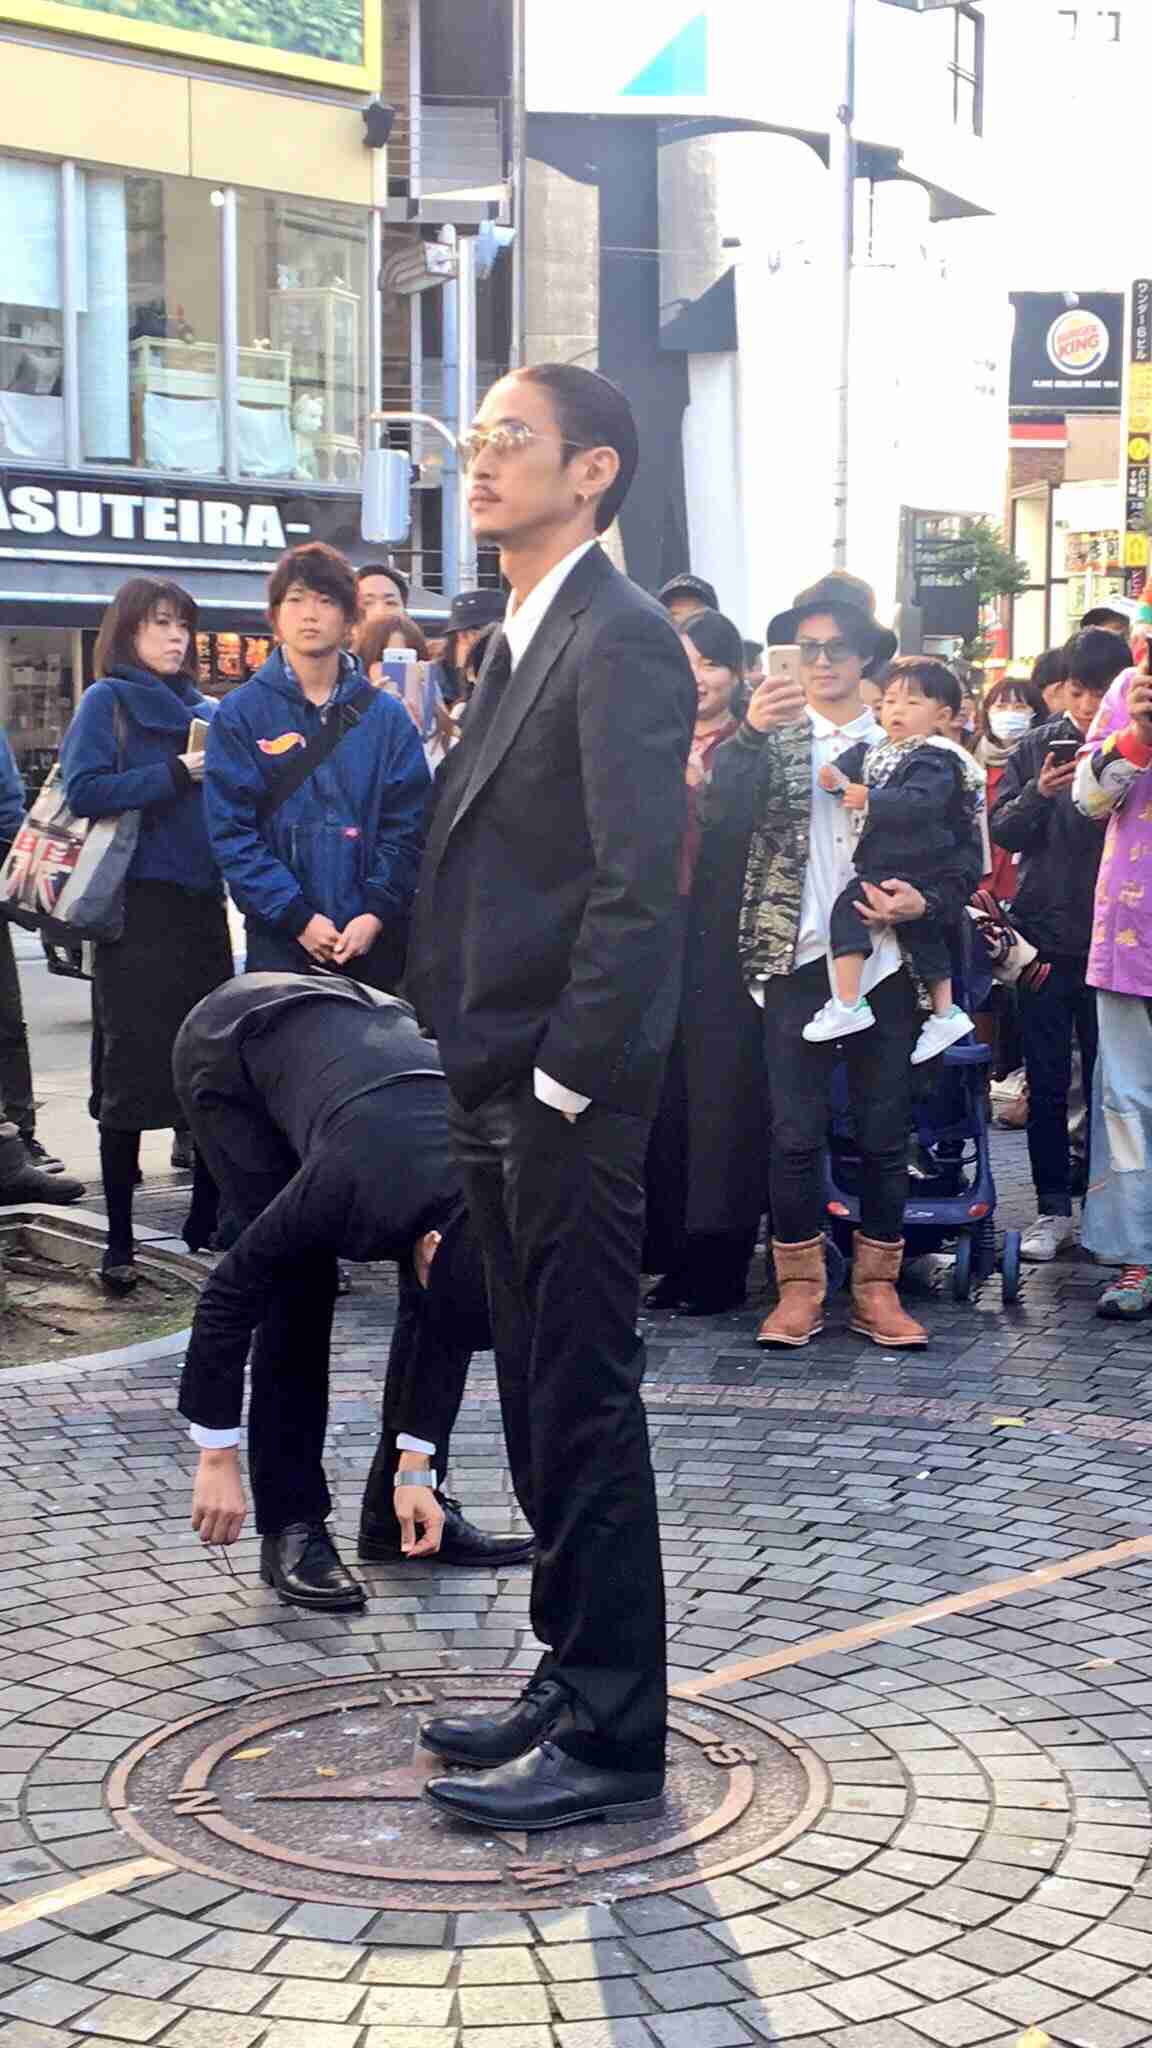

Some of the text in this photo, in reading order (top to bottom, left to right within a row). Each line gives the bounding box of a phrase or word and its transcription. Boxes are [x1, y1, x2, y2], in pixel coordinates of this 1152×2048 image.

[1056, 334, 1100, 359] KING
[703, 1743, 757, 1767] S
[168, 1791, 222, 1815] N
